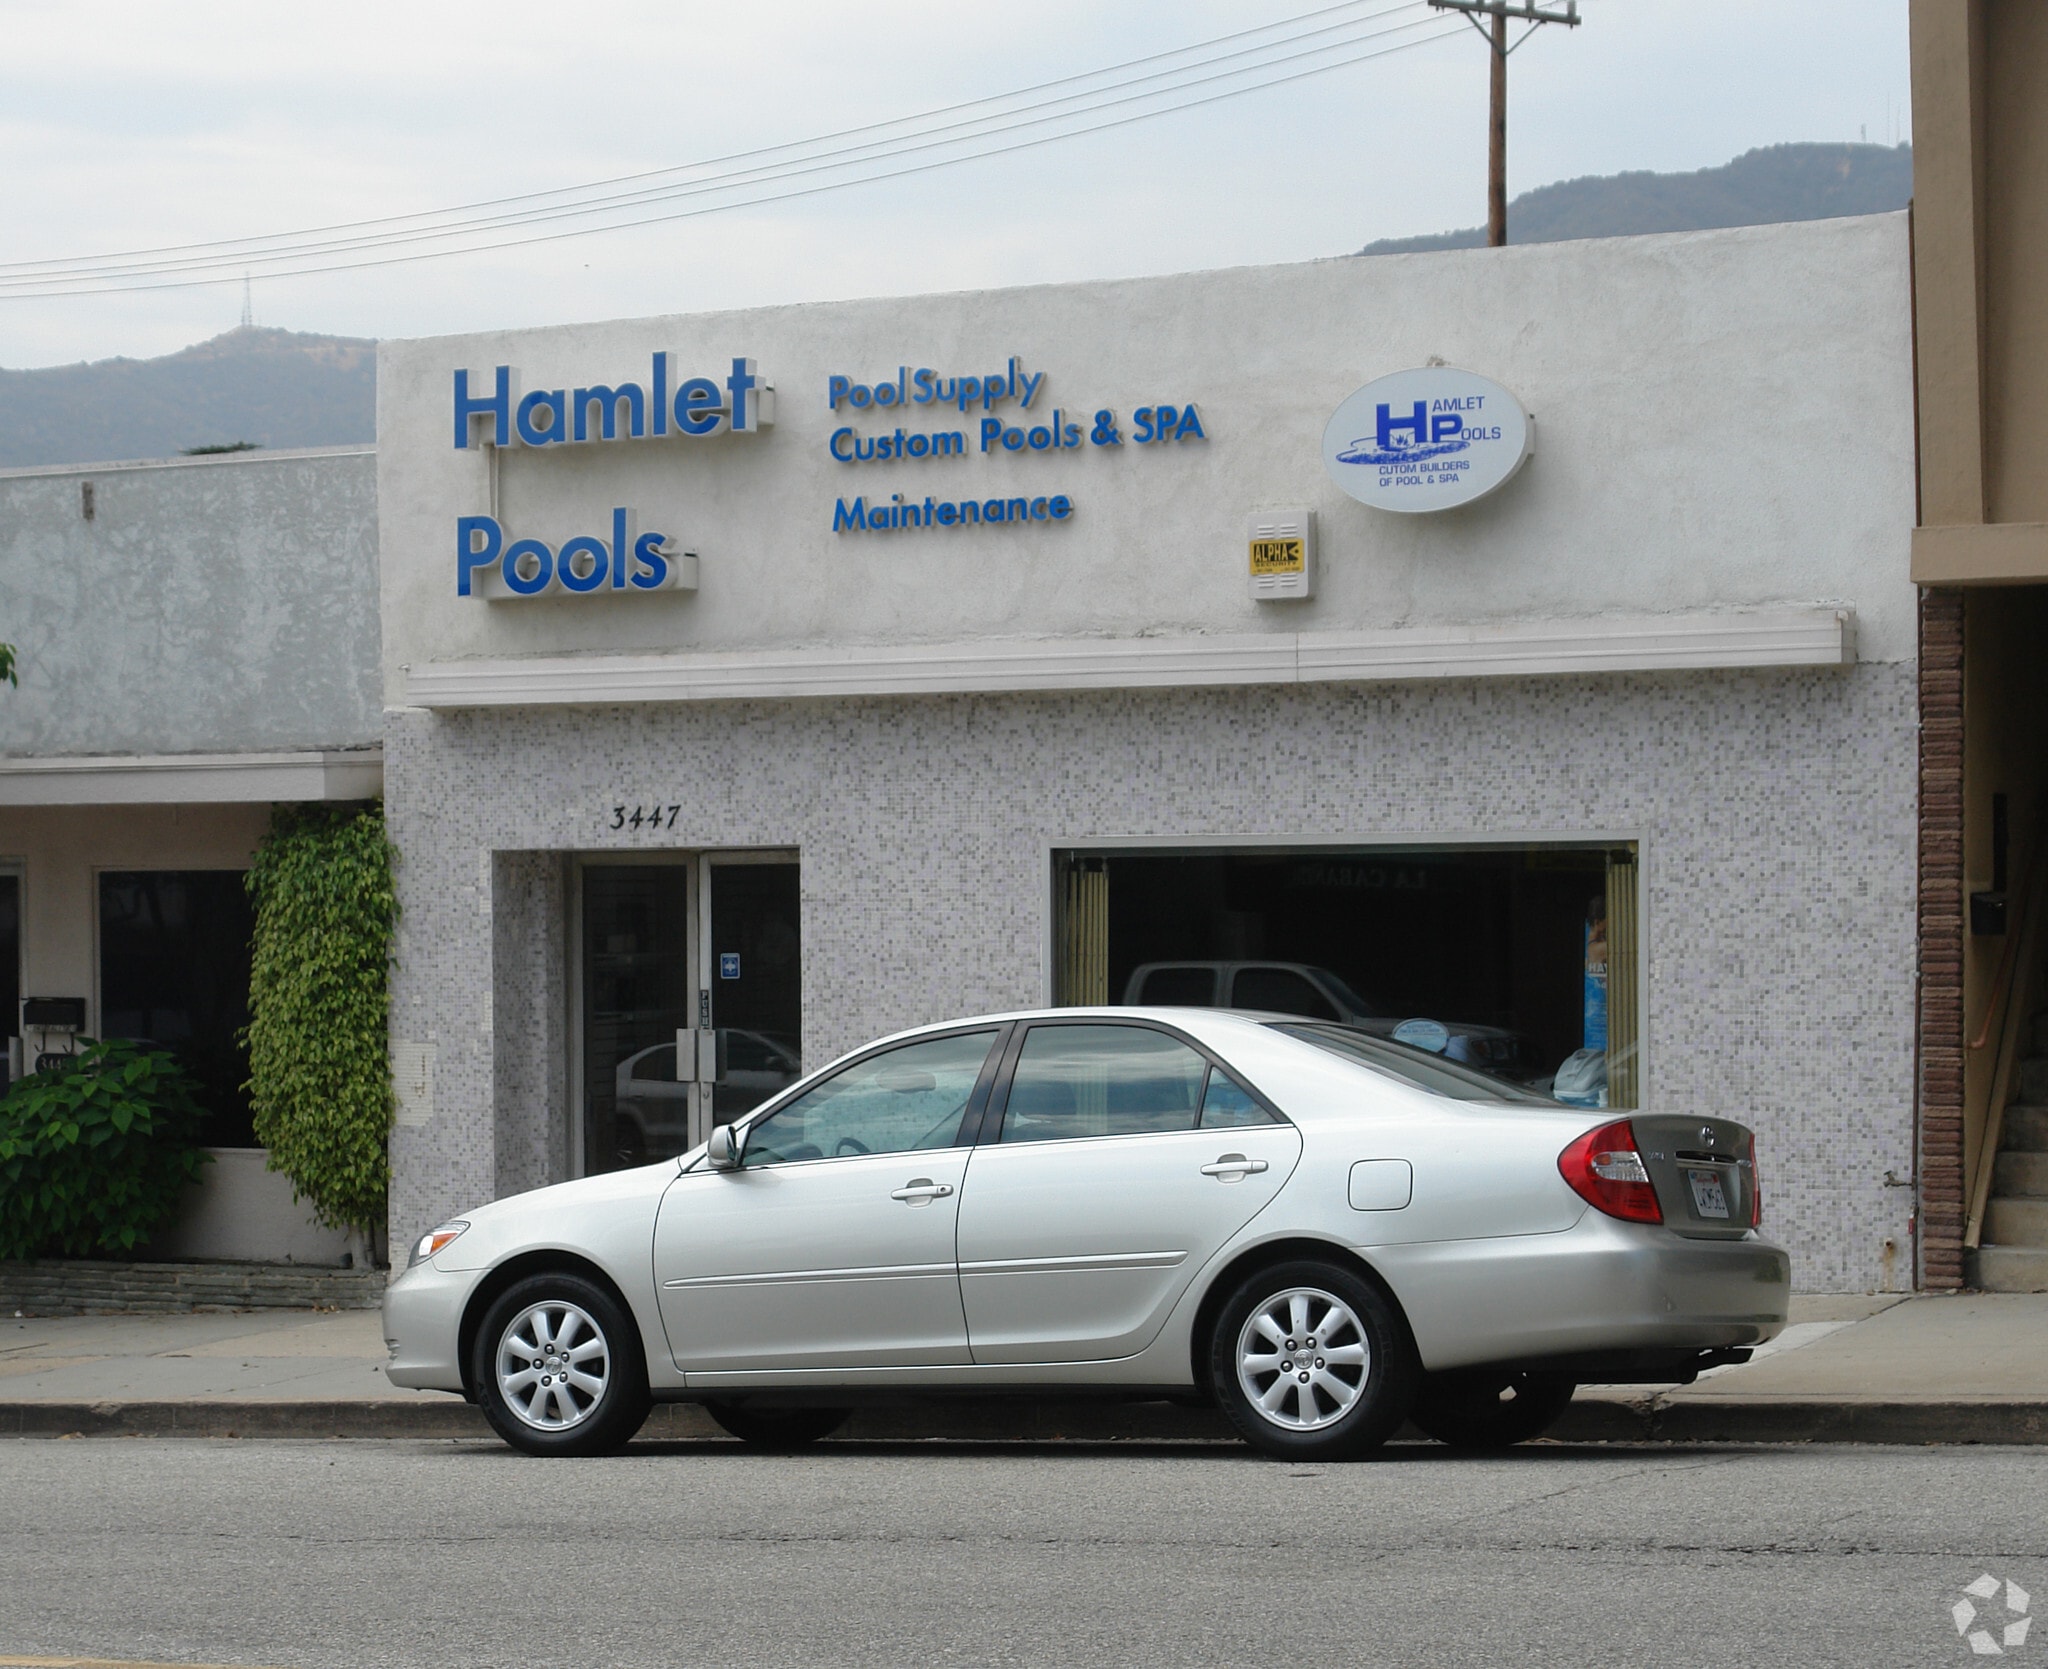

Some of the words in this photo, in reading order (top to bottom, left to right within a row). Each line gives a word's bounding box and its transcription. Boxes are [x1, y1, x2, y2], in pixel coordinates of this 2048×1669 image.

[453, 351, 758, 450] Hamlet
[829, 366, 907, 410] Pool
[913, 356, 1045, 411] Supply
[830, 427, 965, 462] Custom
[980, 409, 1082, 453] Pools
[1090, 409, 1121, 446] &
[1132, 403, 1208, 443] SPA
[1379, 464, 1417, 475] CUTOM
[1420, 460, 1470, 473] BUILDERS
[1379, 476, 1393, 487] OF
[1396, 475, 1423, 486] POOL
[1427, 474, 1435, 484] &
[1439, 473, 1459, 483] SPA
[832, 493, 1074, 532] Maintenance
[457, 506, 669, 598] Pools
[1255, 543, 1289, 562] ALPHA
[609, 804, 682, 830] 3447
